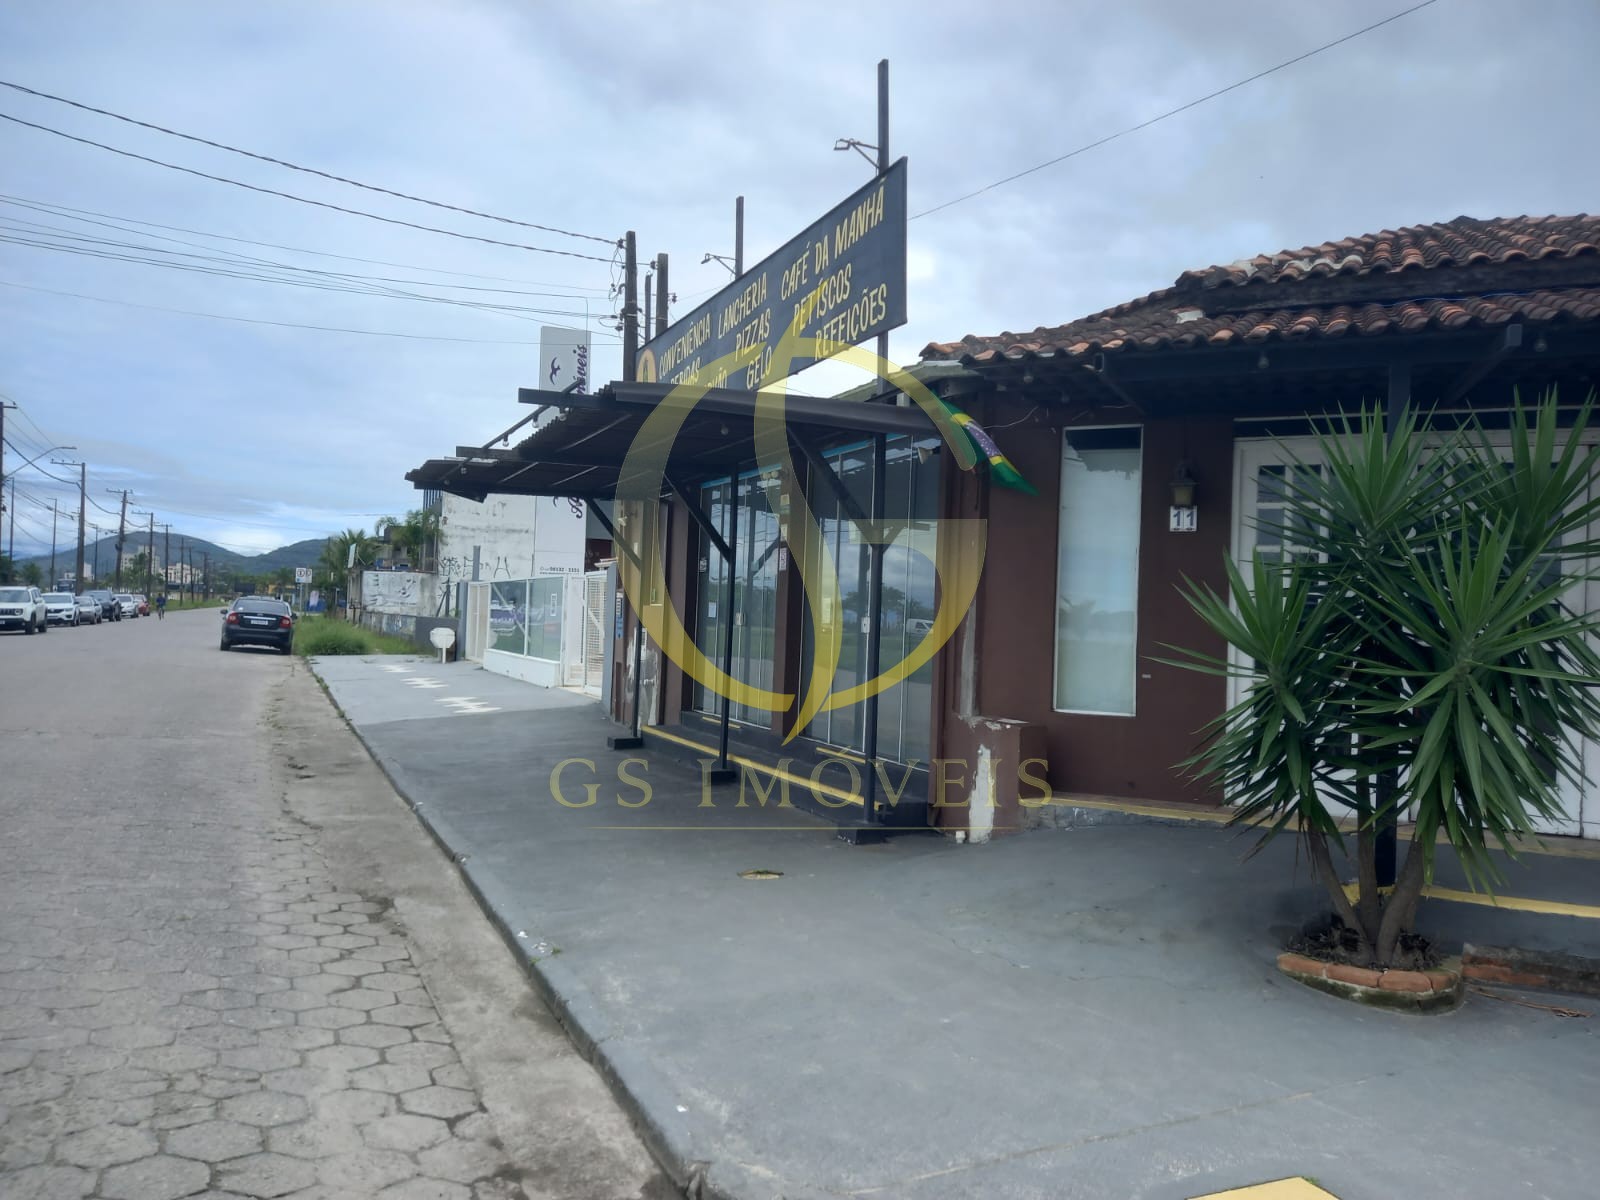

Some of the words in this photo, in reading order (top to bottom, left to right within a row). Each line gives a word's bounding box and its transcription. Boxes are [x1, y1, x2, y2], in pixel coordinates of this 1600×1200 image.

[658, 313, 711, 379] CONVENIÊNCIA
[718, 271, 767, 339] LANCHERIA
[781, 241, 810, 301] CAFÉ
[814, 234, 829, 275] DA
[834, 176, 887, 260] MANHÃ
[735, 307, 771, 362] PIZZAS
[746, 345, 772, 390] GELO
[815, 283, 887, 362] REFEIÇÕES
[1173, 510, 1194, 527] 11
